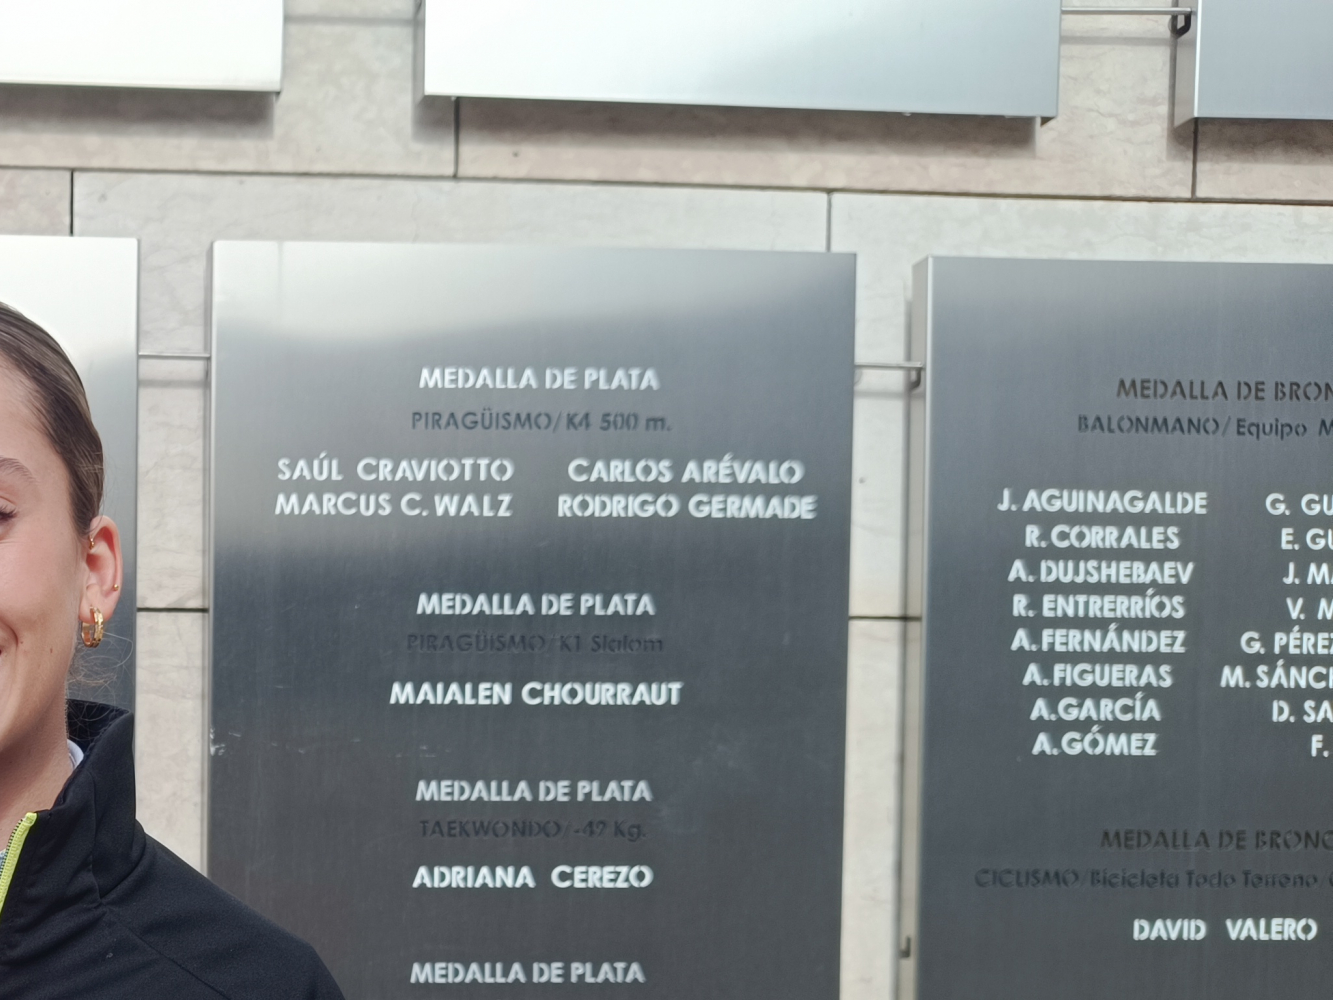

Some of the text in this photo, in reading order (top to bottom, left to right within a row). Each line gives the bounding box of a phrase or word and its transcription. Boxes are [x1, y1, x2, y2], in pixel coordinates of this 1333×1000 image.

[420, 368, 659, 390] MEDALLA DE PLATA
[1117, 379, 1228, 400] MEDALLA
[1237, 381, 1265, 401] DE
[600, 412, 639, 431] 500
[278, 452, 514, 481] SAÚL CRAVIOTTO
[568, 454, 804, 484] CARLOS ARÉVALO
[275, 492, 512, 517] MARCUS C. WALZ
[558, 494, 815, 519] RODRIGO GERMADE
[1023, 489, 1207, 514] AGUINAGALDE
[1266, 493, 1290, 515] G.
[1051, 524, 1180, 552] CORRALES
[1281, 528, 1299, 550] E.
[1008, 559, 1194, 586] A. DUJSHEBAEV
[1283, 562, 1300, 584] J.
[417, 593, 655, 615] MEDALLA DE PLATA
[1013, 586, 1185, 621] R. ENTRERRÍOS
[1286, 598, 1305, 619] V.
[1042, 621, 1186, 655] FERNÁNDEZ
[1240, 631, 1265, 654] G.
[1053, 663, 1173, 690] FIGUERAS
[1220, 666, 1250, 688] M.
[390, 682, 682, 705] MAIALEN CHOURRAUT
[1272, 700, 1295, 722] D.
[416, 780, 652, 801] MEDALLA DE PLATA
[1100, 830, 1333, 851] MEDALLA DE BRONC
[413, 865, 653, 888] ADRIANA CEREZO
[1185, 869, 1236, 888] Todo
[1133, 918, 1318, 940] DAVID VALERO
[410, 962, 645, 983] MEDALLA DE PLATA
